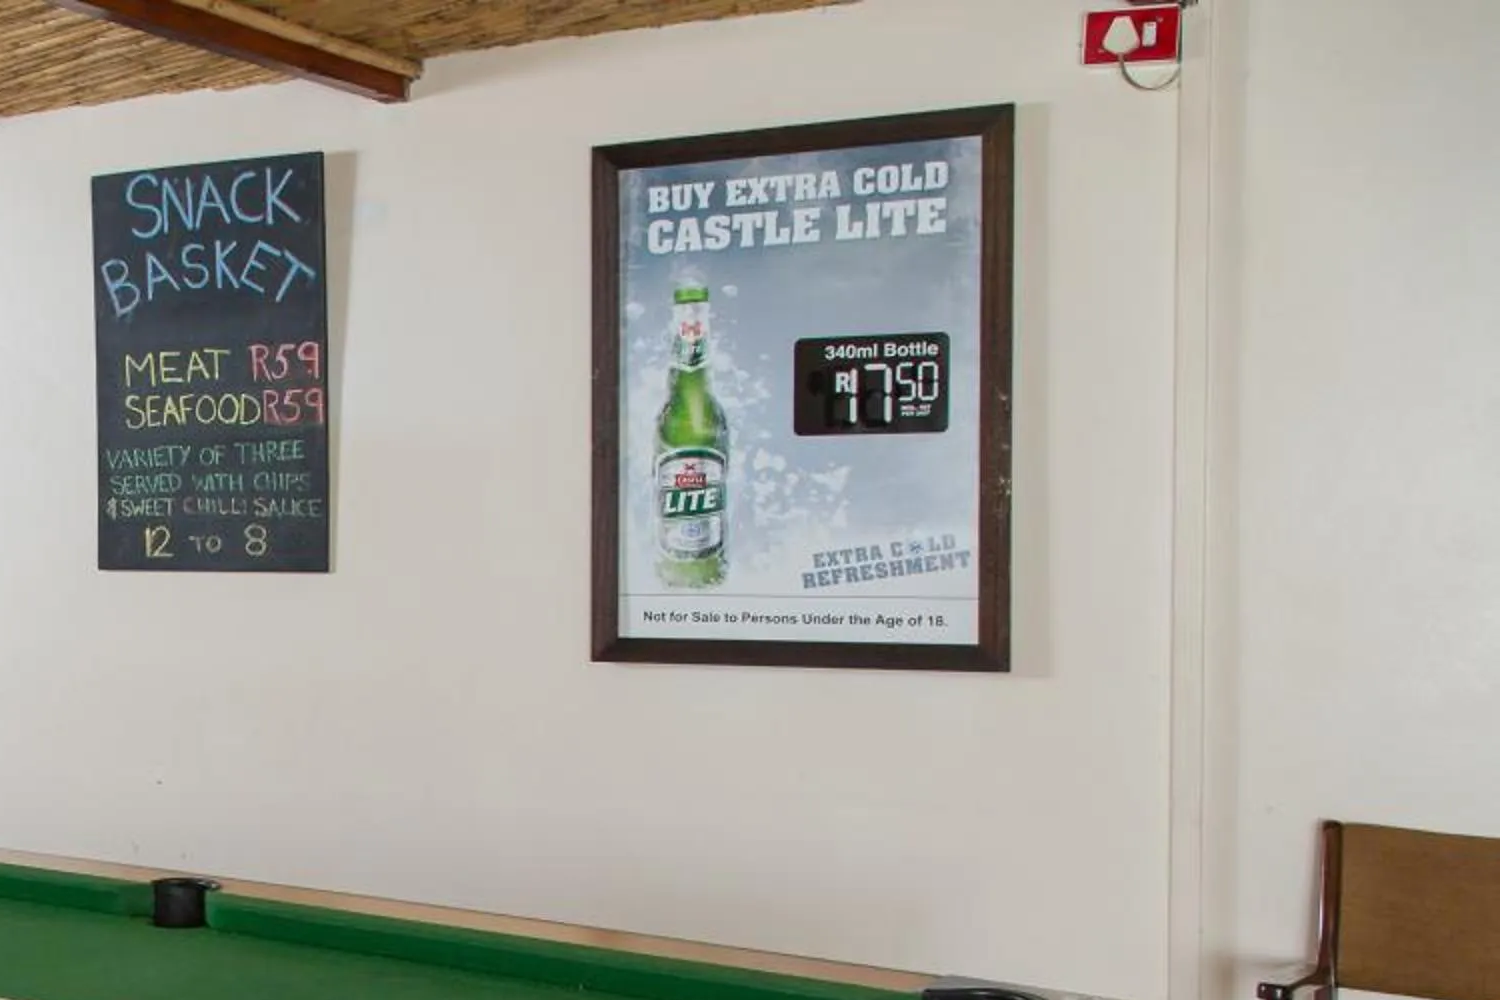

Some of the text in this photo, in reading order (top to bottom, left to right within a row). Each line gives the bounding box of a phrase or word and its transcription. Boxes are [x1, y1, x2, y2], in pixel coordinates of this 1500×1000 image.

[125, 167, 300, 238] SNACK
[648, 160, 949, 213] BUY EXTRA COLD
[647, 197, 947, 255] CASTLE LITE
[101, 240, 316, 318] BASKET
[125, 341, 320, 388] MEAT R59
[824, 341, 939, 360] 340ml Bottle
[125, 388, 323, 429] SEAFOOD R59
[105, 439, 305, 469] VARIETY OF THREE
[109, 471, 312, 495] SERVED WITH CHIPS
[664, 488, 717, 512] LITE
[120, 498, 173, 517] SWEET
[254, 496, 323, 518] SAUCE
[144, 525, 174, 557] 12
[244, 522, 267, 556] 8
[812, 545, 883, 569] EXTRA
[801, 550, 971, 589] REFRESHMENT
[643, 611, 666, 623] Not
[669, 611, 689, 623] for
[691, 611, 719, 623] Sale
[724, 612, 737, 624] to
[741, 612, 797, 625] Persons
[802, 613, 844, 626] Under
[849, 613, 871, 626] the
[875, 614, 903, 629] Age
[907, 614, 922, 627] of
